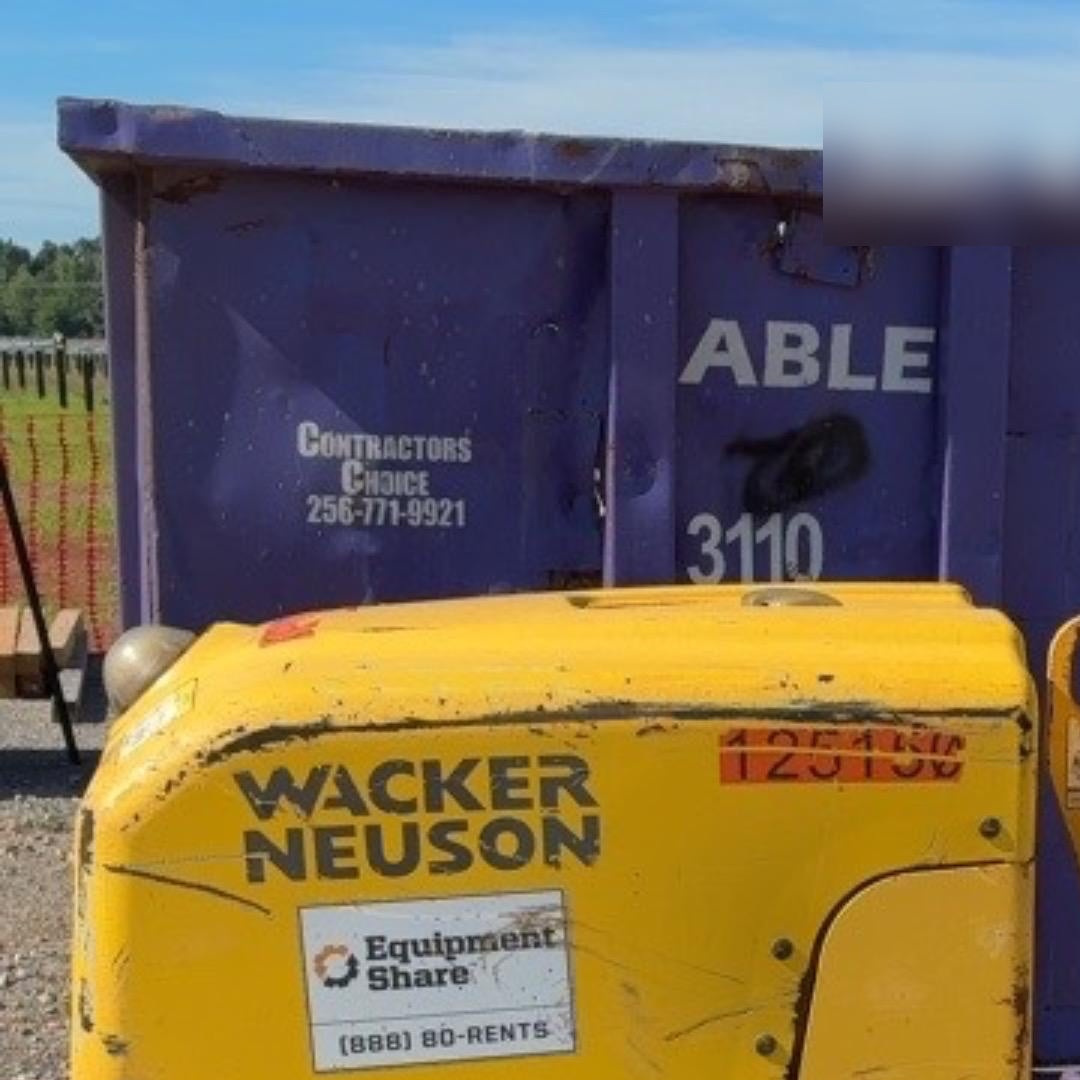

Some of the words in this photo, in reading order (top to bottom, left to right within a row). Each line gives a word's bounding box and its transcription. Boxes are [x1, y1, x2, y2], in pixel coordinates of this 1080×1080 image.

[677, 317, 936, 393] ABLE
[305, 495, 466, 527] 256-771-9921
[686, 511, 824, 584] 3110
[233, 755, 600, 821] WACKER
[243, 815, 600, 882] NEUSON
[364, 926, 556, 963] Equipment
[367, 964, 470, 991] Share
[338, 1031, 412, 1056] (888)
[422, 1022, 549, 1048] 80-RENTS
